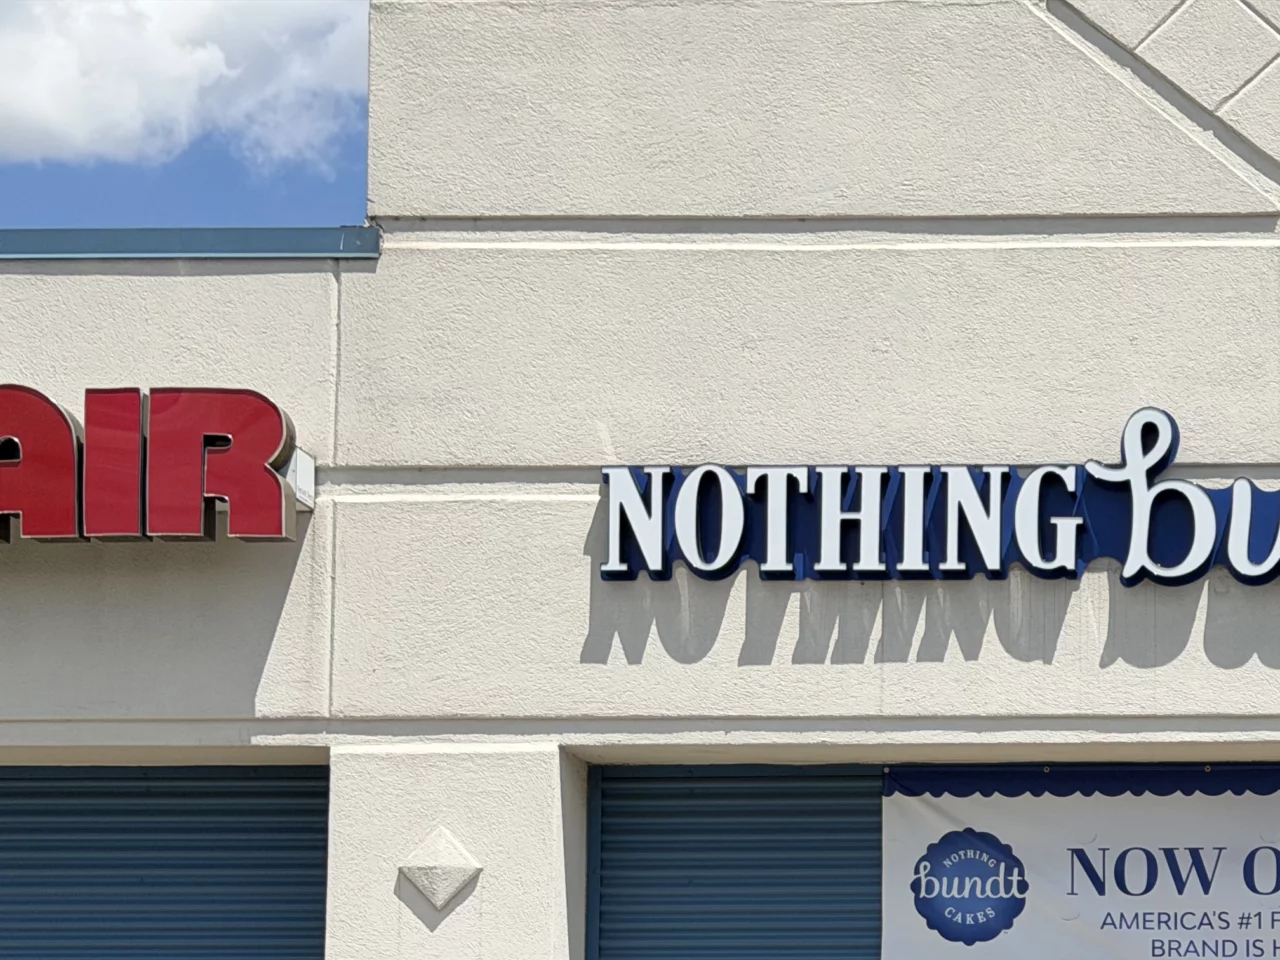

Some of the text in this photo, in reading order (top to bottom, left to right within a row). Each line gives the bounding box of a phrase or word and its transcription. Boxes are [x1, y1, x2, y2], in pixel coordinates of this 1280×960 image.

[600, 463, 1086, 580] NOTHING
[942, 849, 997, 868] NOTHING
[912, 861, 1027, 899] bundt
[1066, 846, 1227, 897] NOW
[944, 906, 996, 925] CAKES
[1100, 910, 1230, 931] AMERICA'S
[1238, 911, 1263, 930] #1
[1151, 938, 1238, 958] BRAND
[1245, 938, 1265, 958] IS
